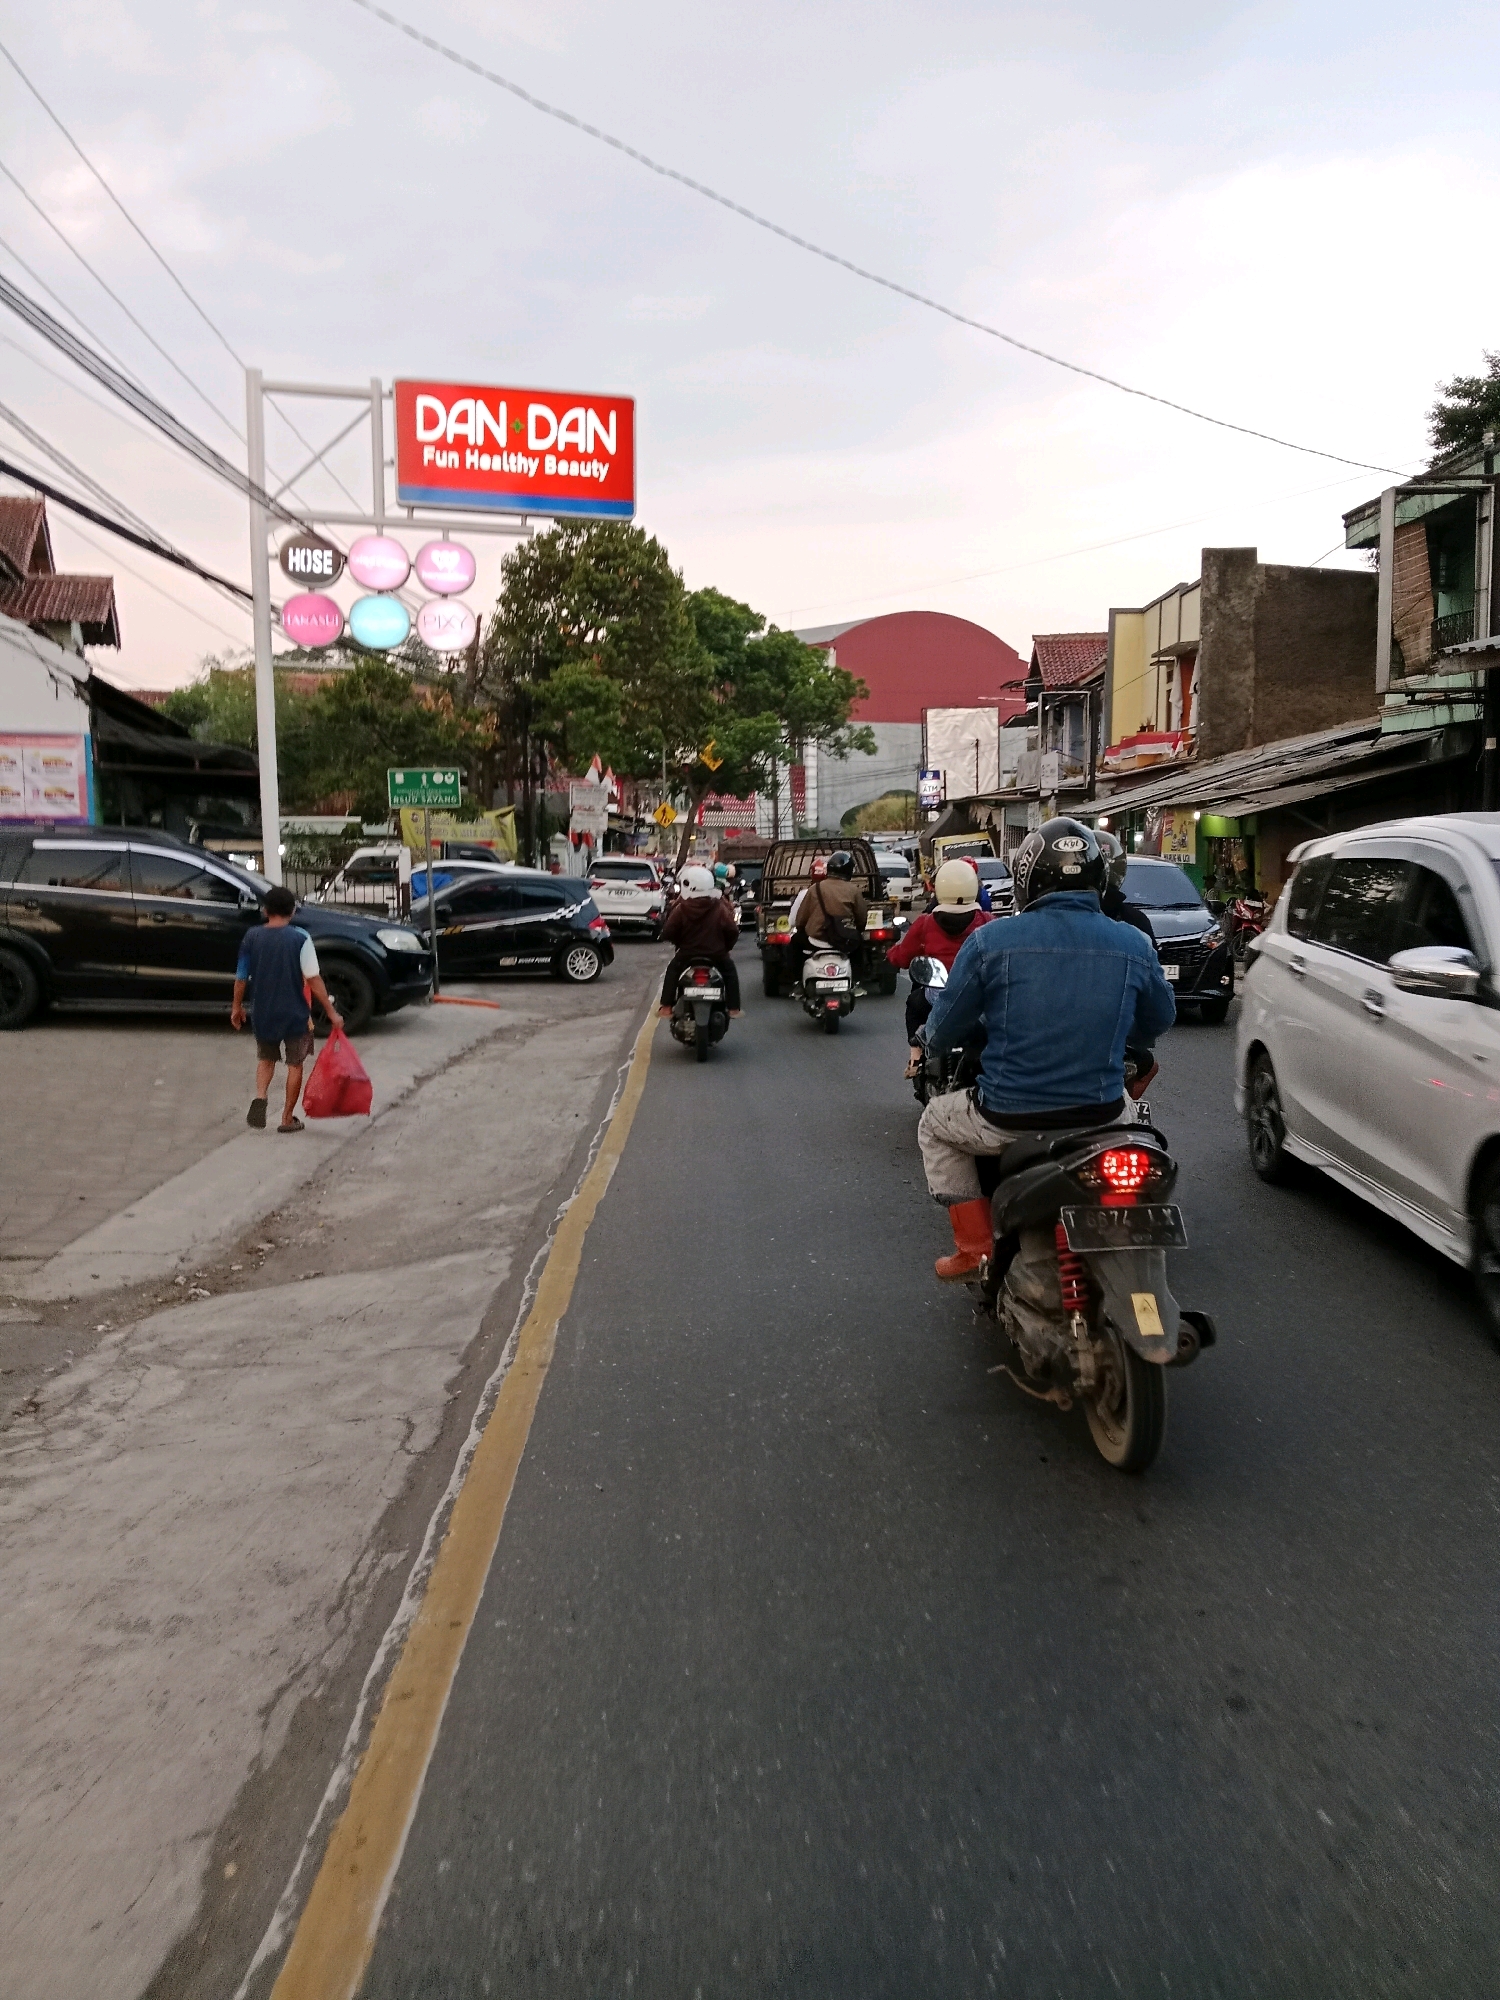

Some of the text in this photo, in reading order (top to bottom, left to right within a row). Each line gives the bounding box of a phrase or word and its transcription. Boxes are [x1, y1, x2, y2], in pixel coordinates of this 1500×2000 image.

[416, 394, 616, 455] DAN DAN
[423, 445, 609, 482] Fun Healthy Beauty
[423, 614, 470, 630] PIXY
[1167, 966, 1178, 975] ZI
